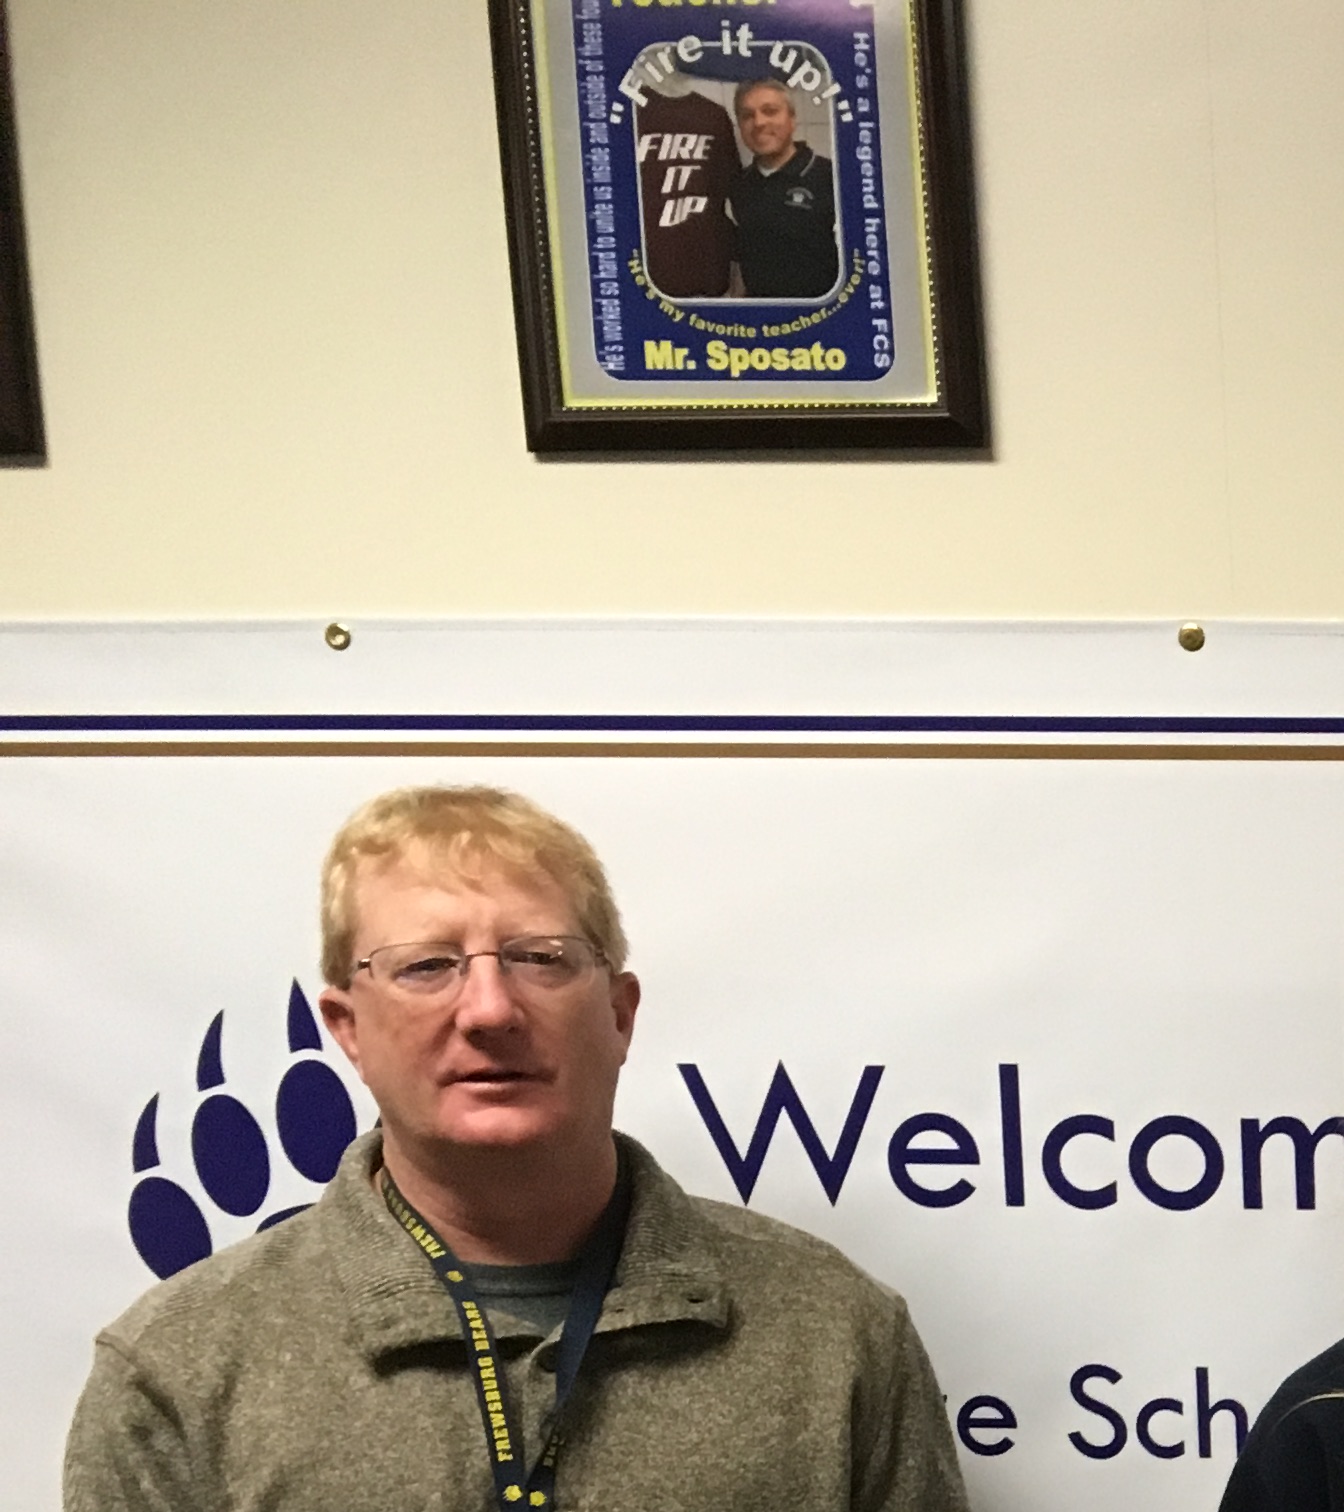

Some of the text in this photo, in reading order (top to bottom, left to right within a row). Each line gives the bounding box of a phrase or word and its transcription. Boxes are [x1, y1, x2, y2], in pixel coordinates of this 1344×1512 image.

[721, 19, 753, 57] it
[582, 122, 609, 144] and
[637, 133, 715, 162] FIRE
[593, 186, 612, 200] us
[661, 165, 701, 193] IT
[658, 196, 708, 227] UP
[853, 32, 890, 368] He's a legend here at FCS
[593, 236, 616, 249] to
[591, 251, 618, 279] hard
[600, 281, 620, 296] so
[659, 301, 685, 322] my
[689, 313, 756, 337] favorite
[643, 340, 846, 377] Mr. Sposato
[462, 1301, 513, 1462] FREWSBURG BEARS
